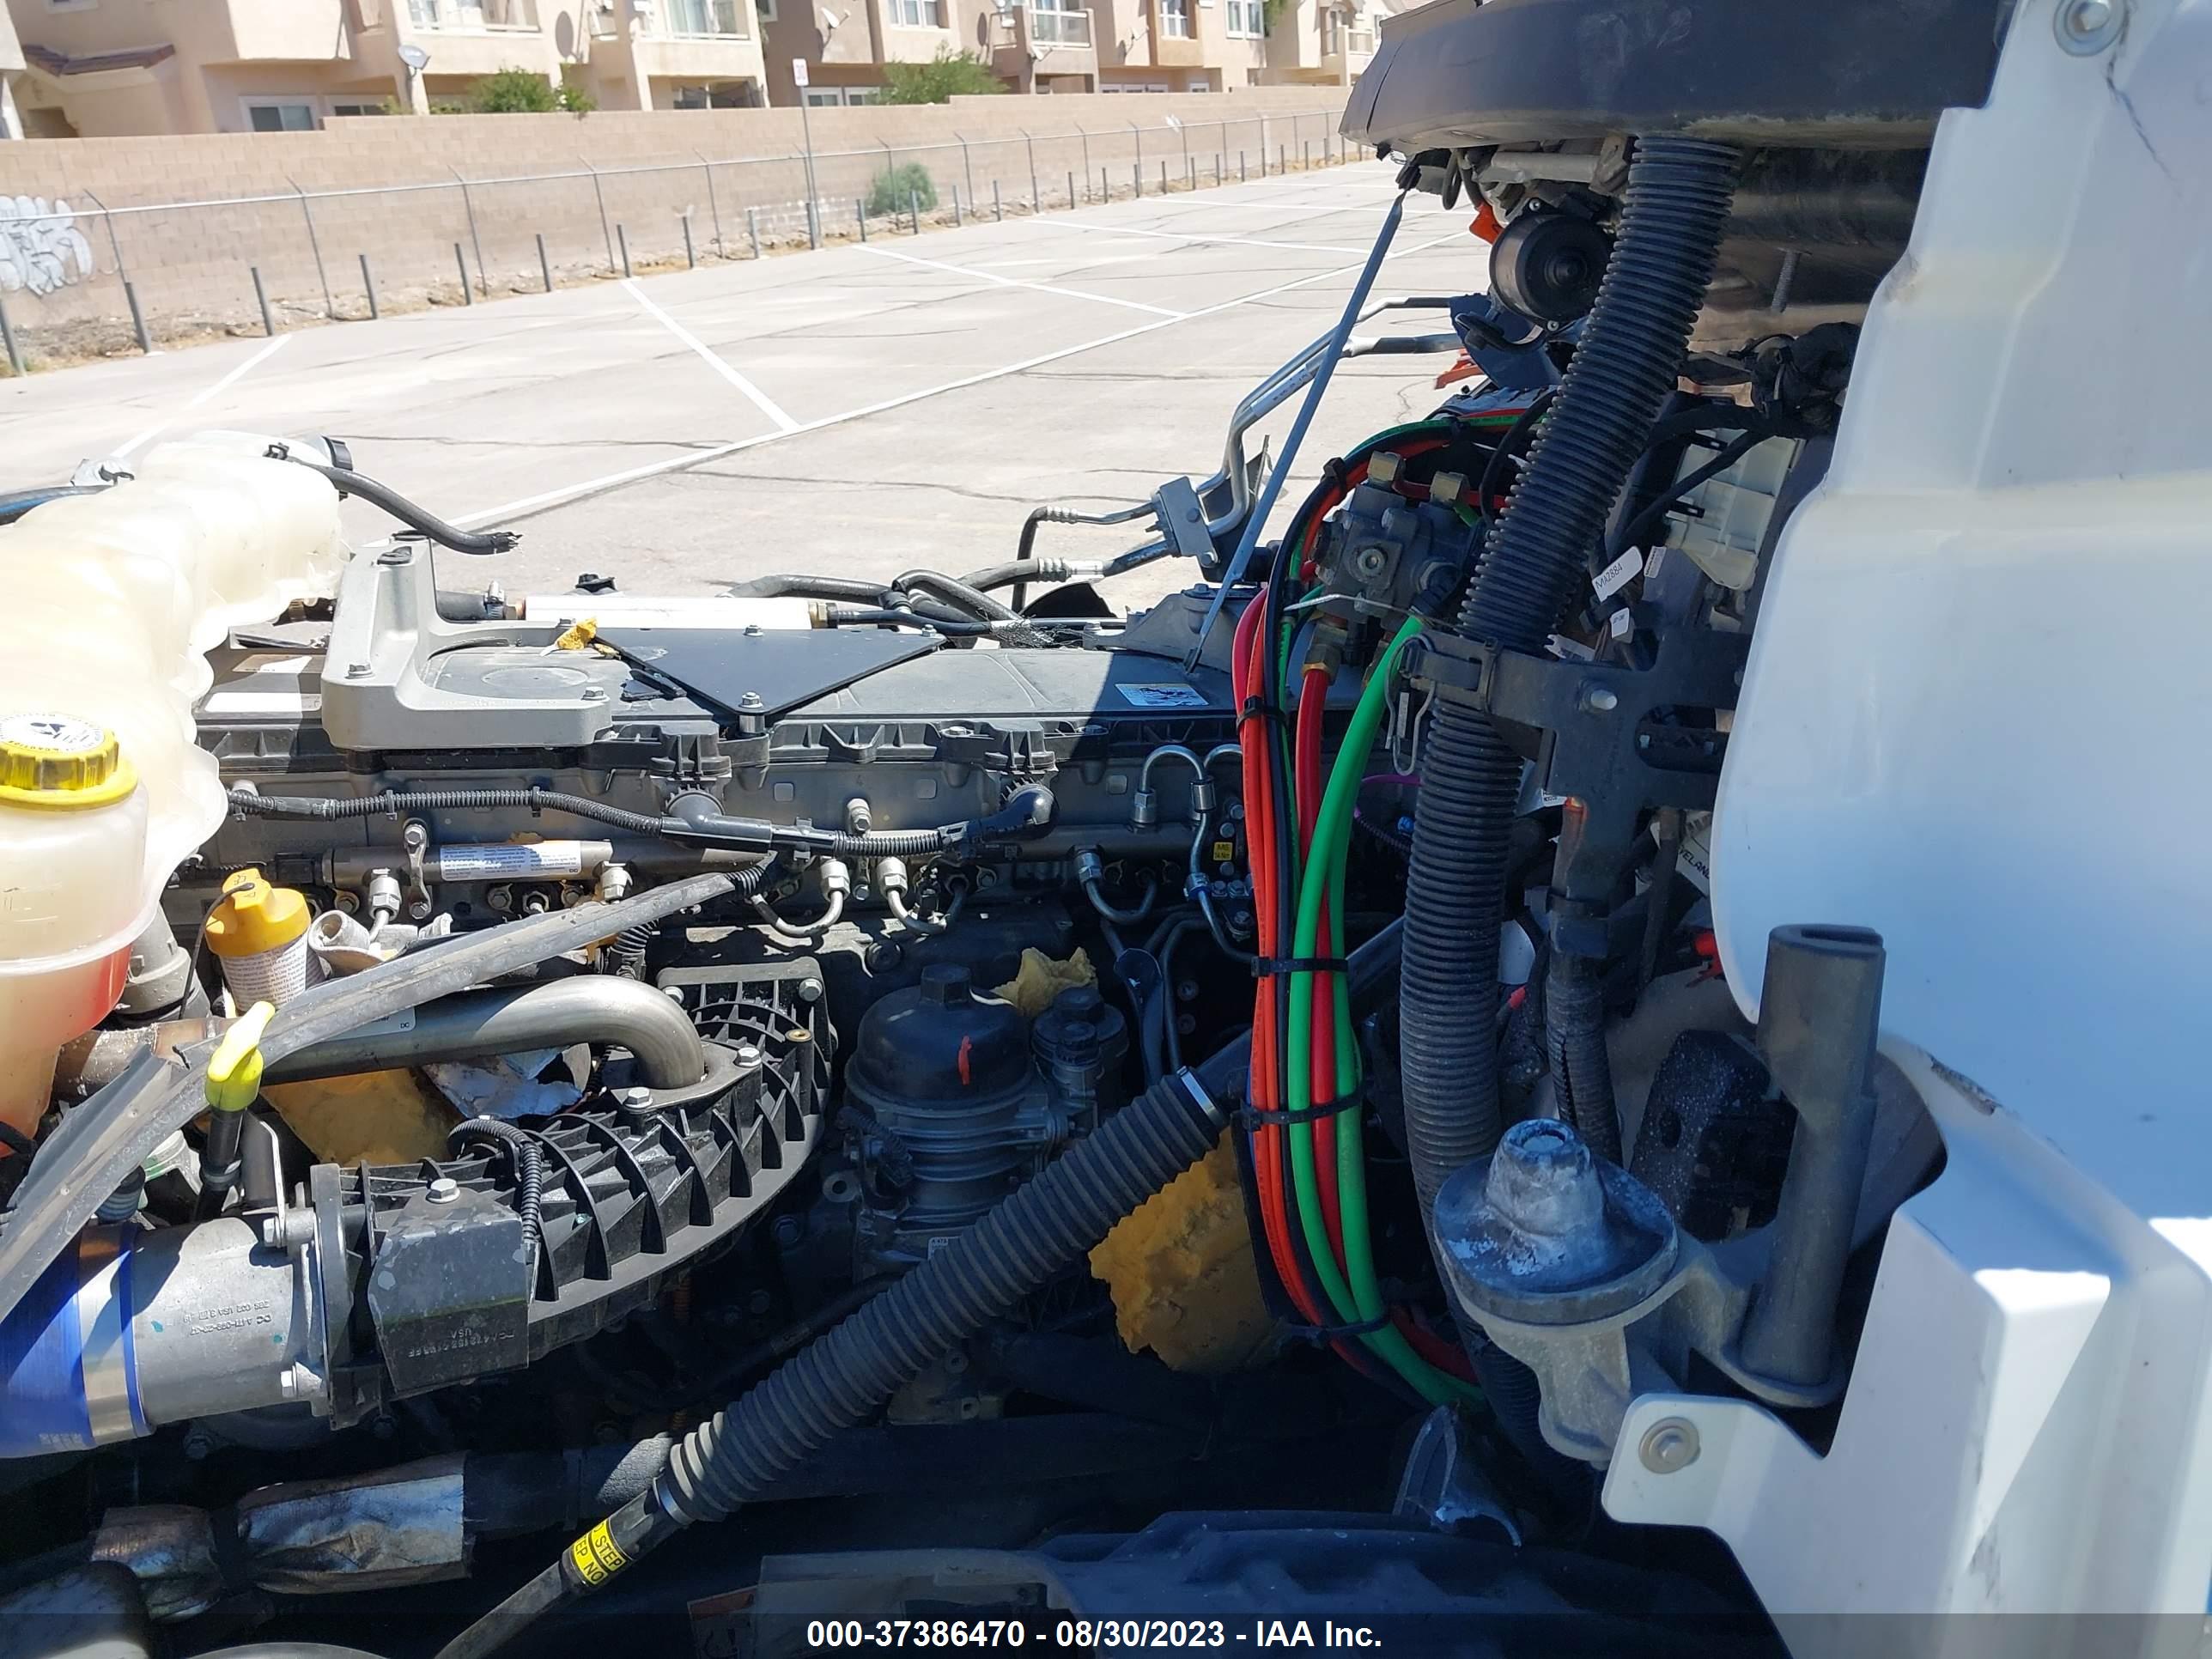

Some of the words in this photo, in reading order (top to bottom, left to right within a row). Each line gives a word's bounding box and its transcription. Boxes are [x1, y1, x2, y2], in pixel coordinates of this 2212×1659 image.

[1595, 562, 1623, 589] MA2884
[448, 1327, 472, 1339] USA
[595, 1535, 623, 1567] STEP
[583, 1562, 604, 1582] NO
